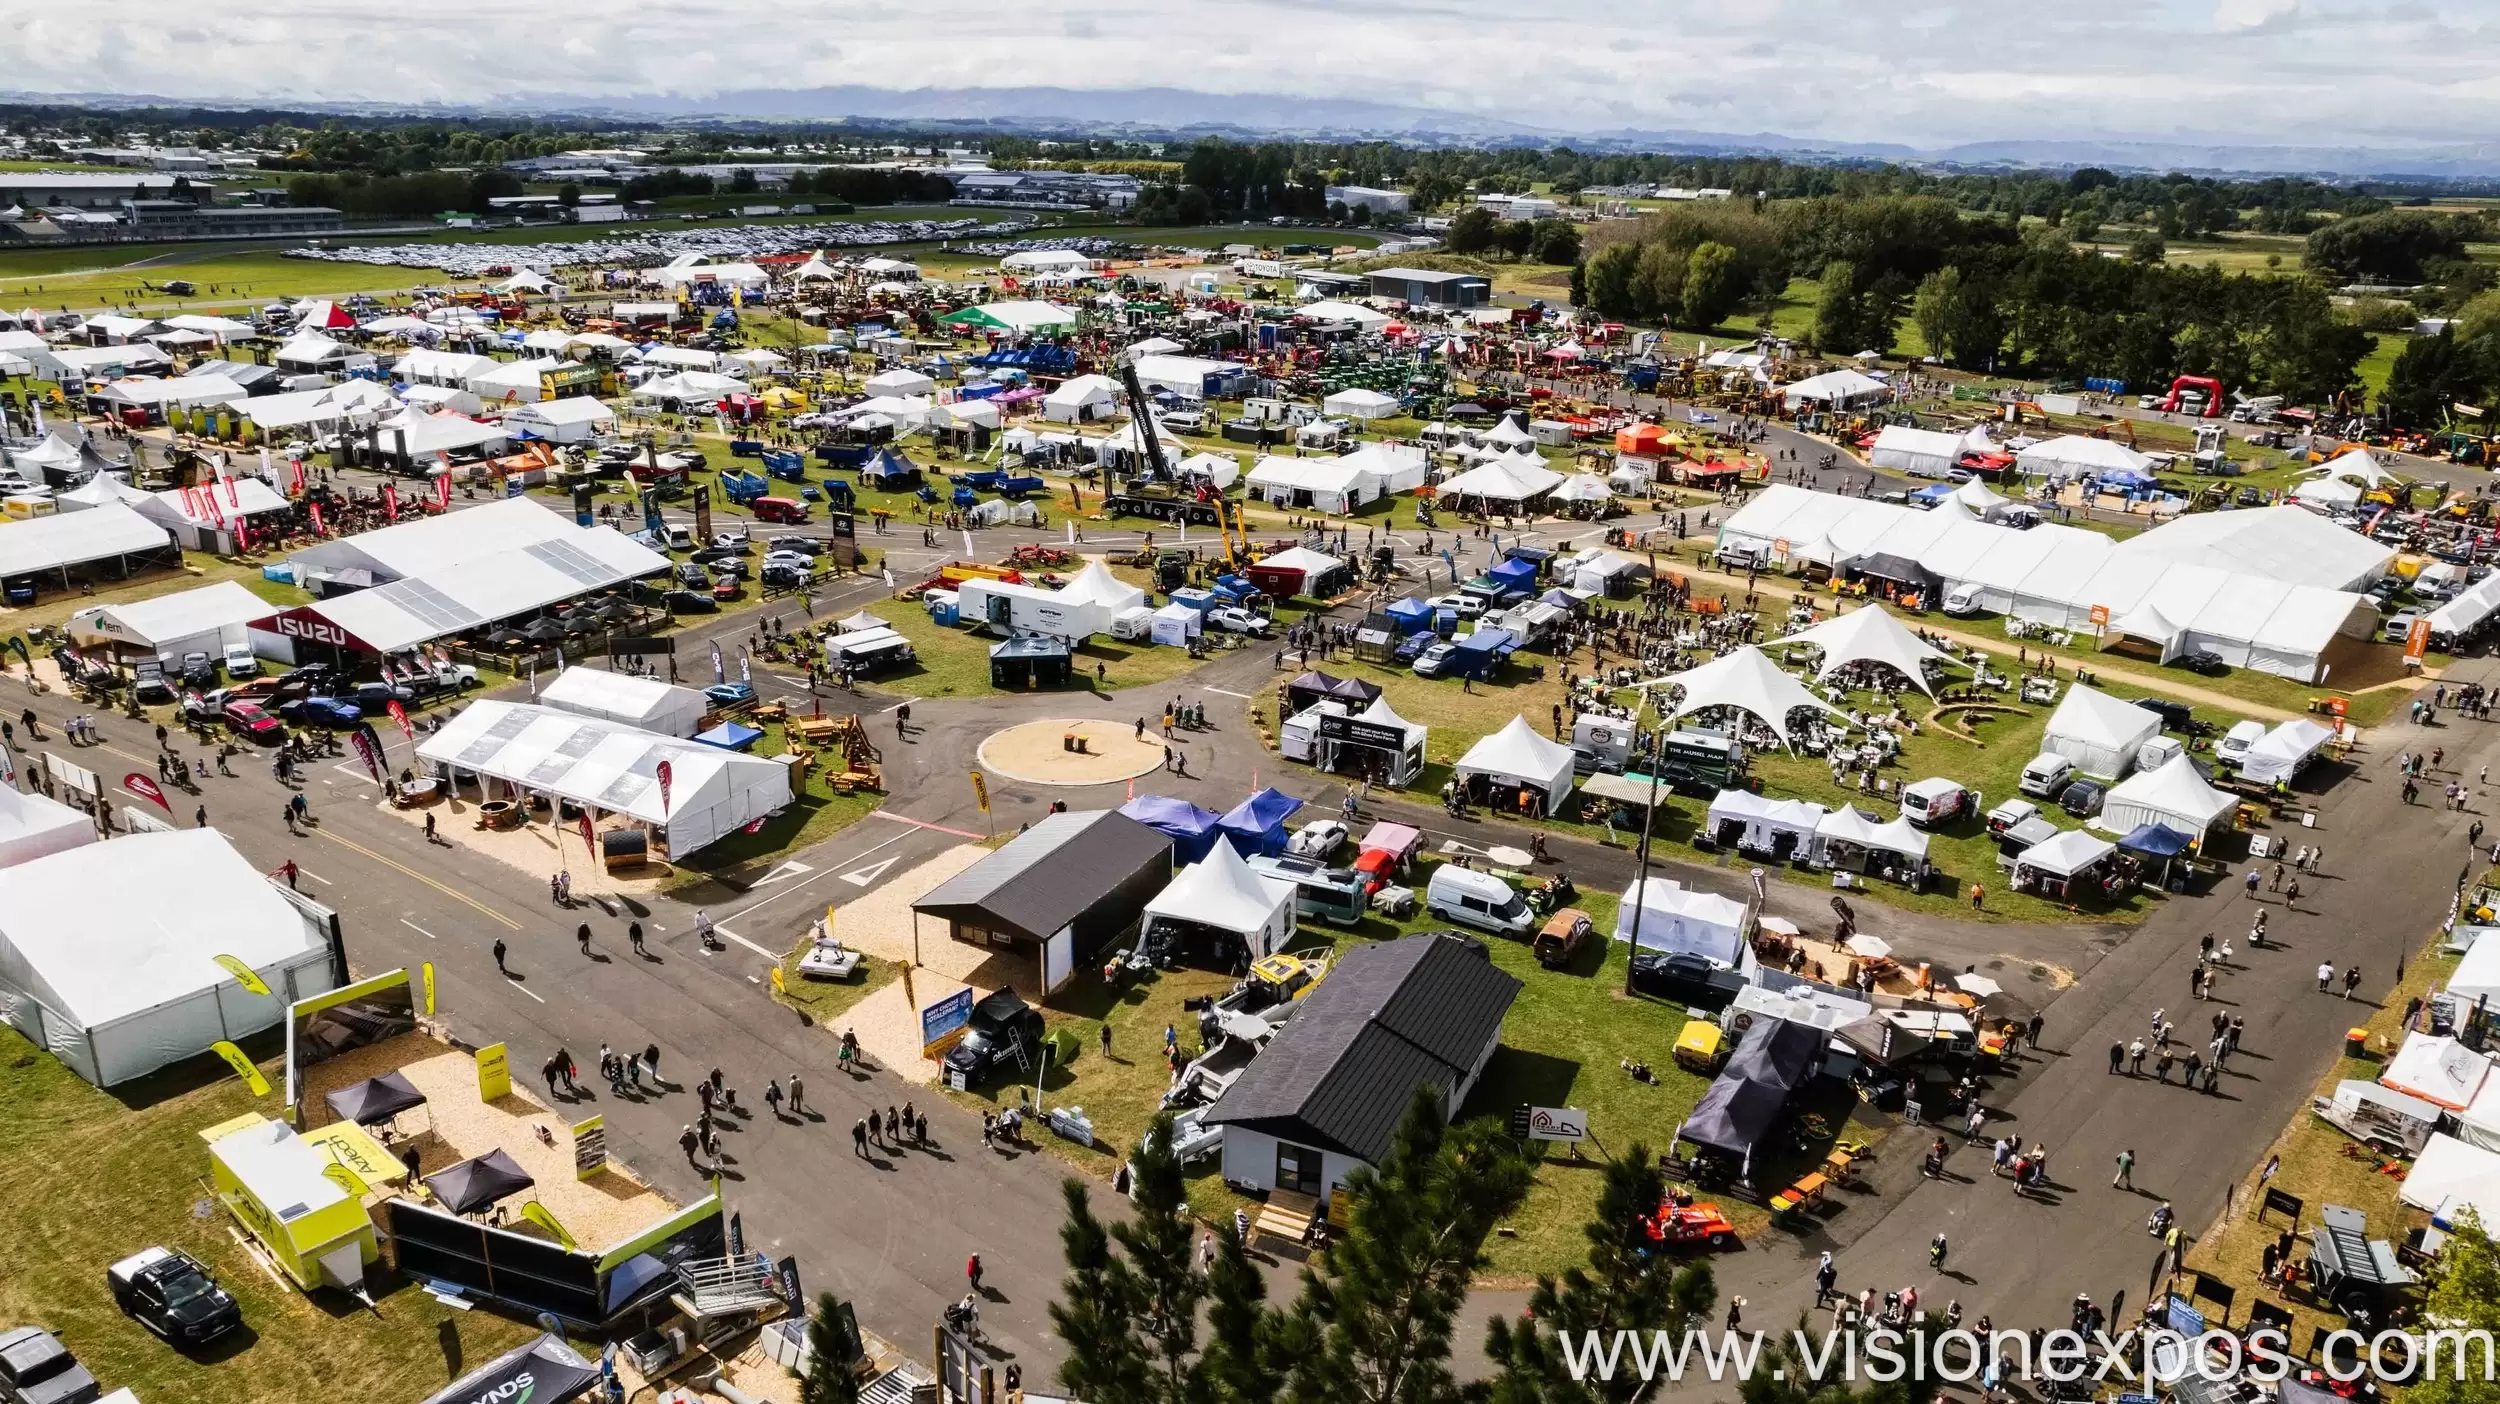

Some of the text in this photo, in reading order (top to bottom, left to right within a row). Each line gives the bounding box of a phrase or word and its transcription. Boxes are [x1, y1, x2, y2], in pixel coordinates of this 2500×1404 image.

[1255, 264, 1277, 273] TOYOTA
[1134, 402, 1150, 436] MCINTOSH
[104, 620, 123, 634] fern
[276, 616, 346, 646] ISUZU
[1683, 749, 1706, 758] MUSSEL
[926, 998, 959, 1017] WHY CHOOSE
[329, 1135, 377, 1173] Aztech
[782, 1270, 797, 1300] HYNDS
[2170, 1298, 2204, 1321] UBCO
[470, 1372, 534, 1404] YNDS
